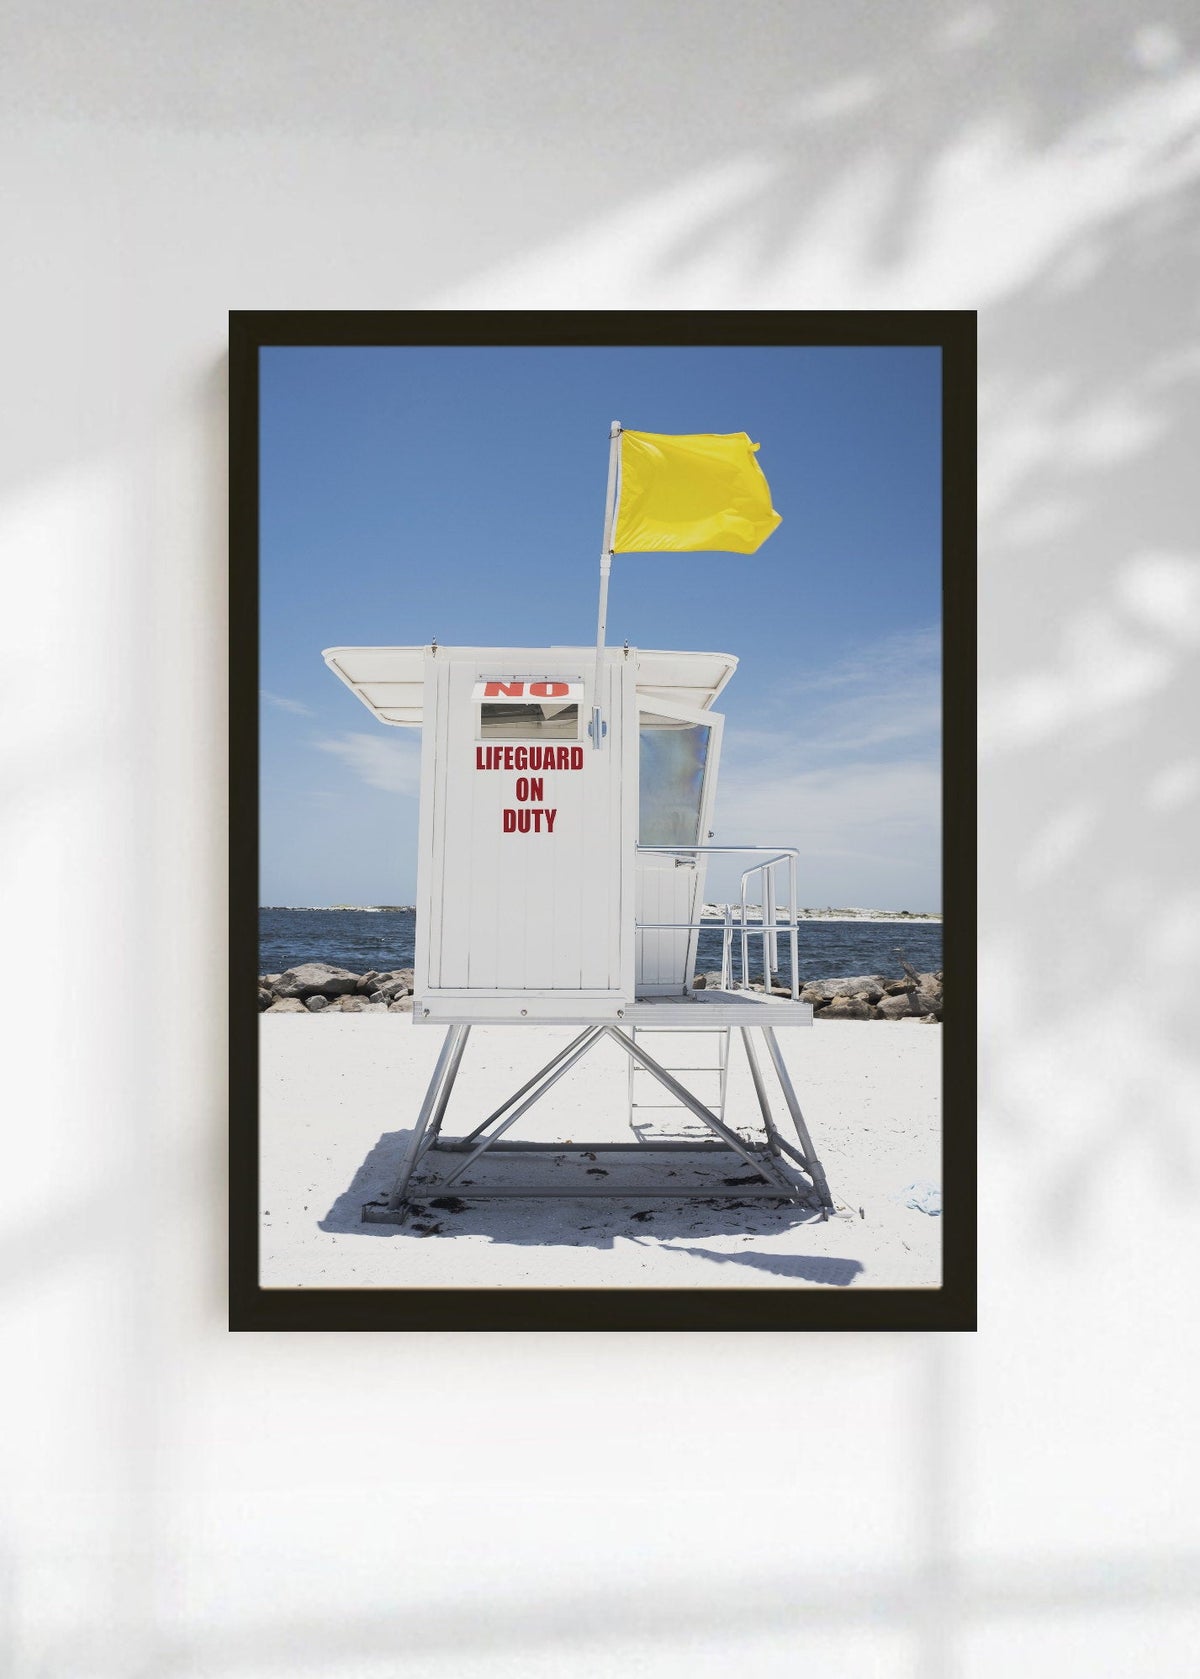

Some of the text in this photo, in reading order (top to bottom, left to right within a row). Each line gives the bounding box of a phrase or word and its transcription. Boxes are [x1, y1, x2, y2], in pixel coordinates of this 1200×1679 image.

[484, 682, 570, 697] NO
[476, 746, 583, 770] LIFEGUARD
[515, 777, 544, 802] ON
[503, 808, 557, 833] DUTY
